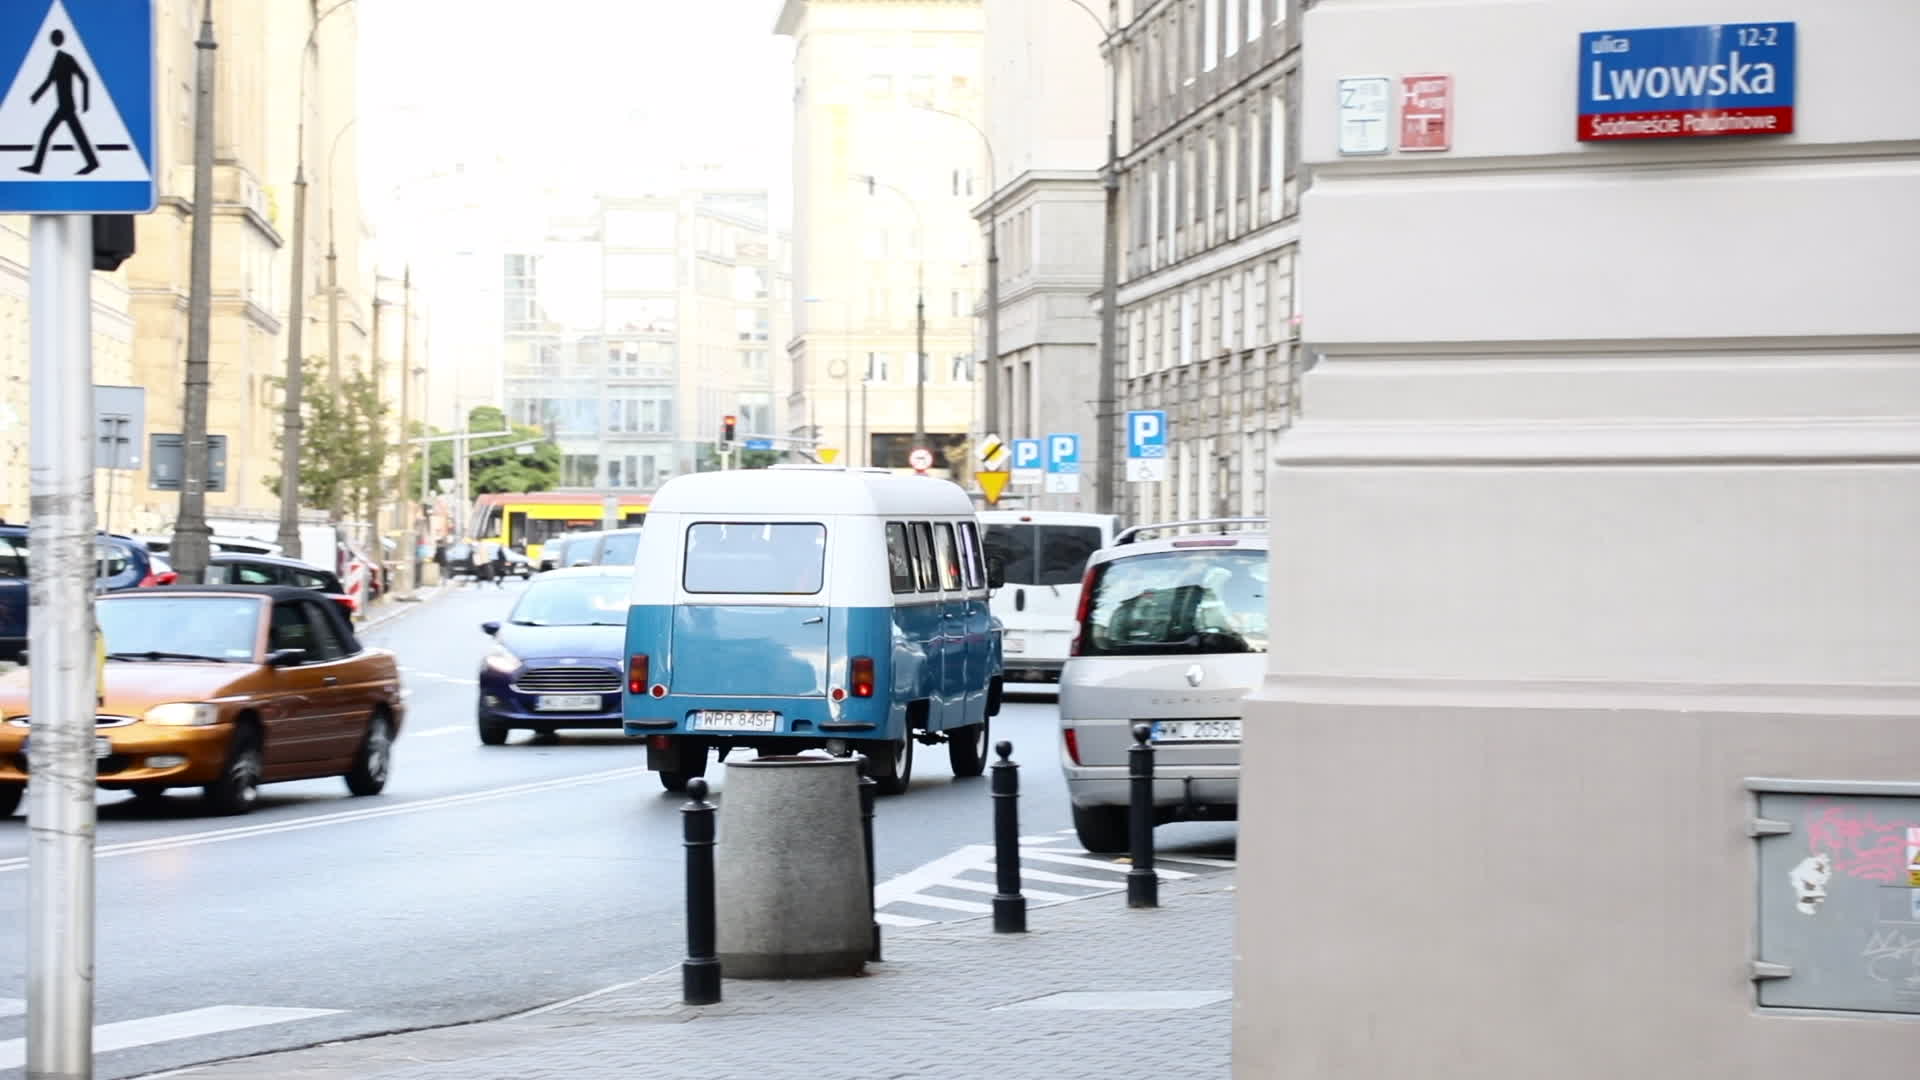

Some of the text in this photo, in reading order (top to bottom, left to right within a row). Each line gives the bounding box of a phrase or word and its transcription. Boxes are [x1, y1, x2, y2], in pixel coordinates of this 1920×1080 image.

[1592, 27, 1777, 54] ulica 12-2
[1592, 51, 1776, 101] Lwowska
[1591, 114, 1681, 136] Śródmieście
[1134, 414, 1160, 446] P
[1017, 442, 1038, 466] P
[1052, 436, 1075, 463] P
[704, 712, 734, 726] WPR
